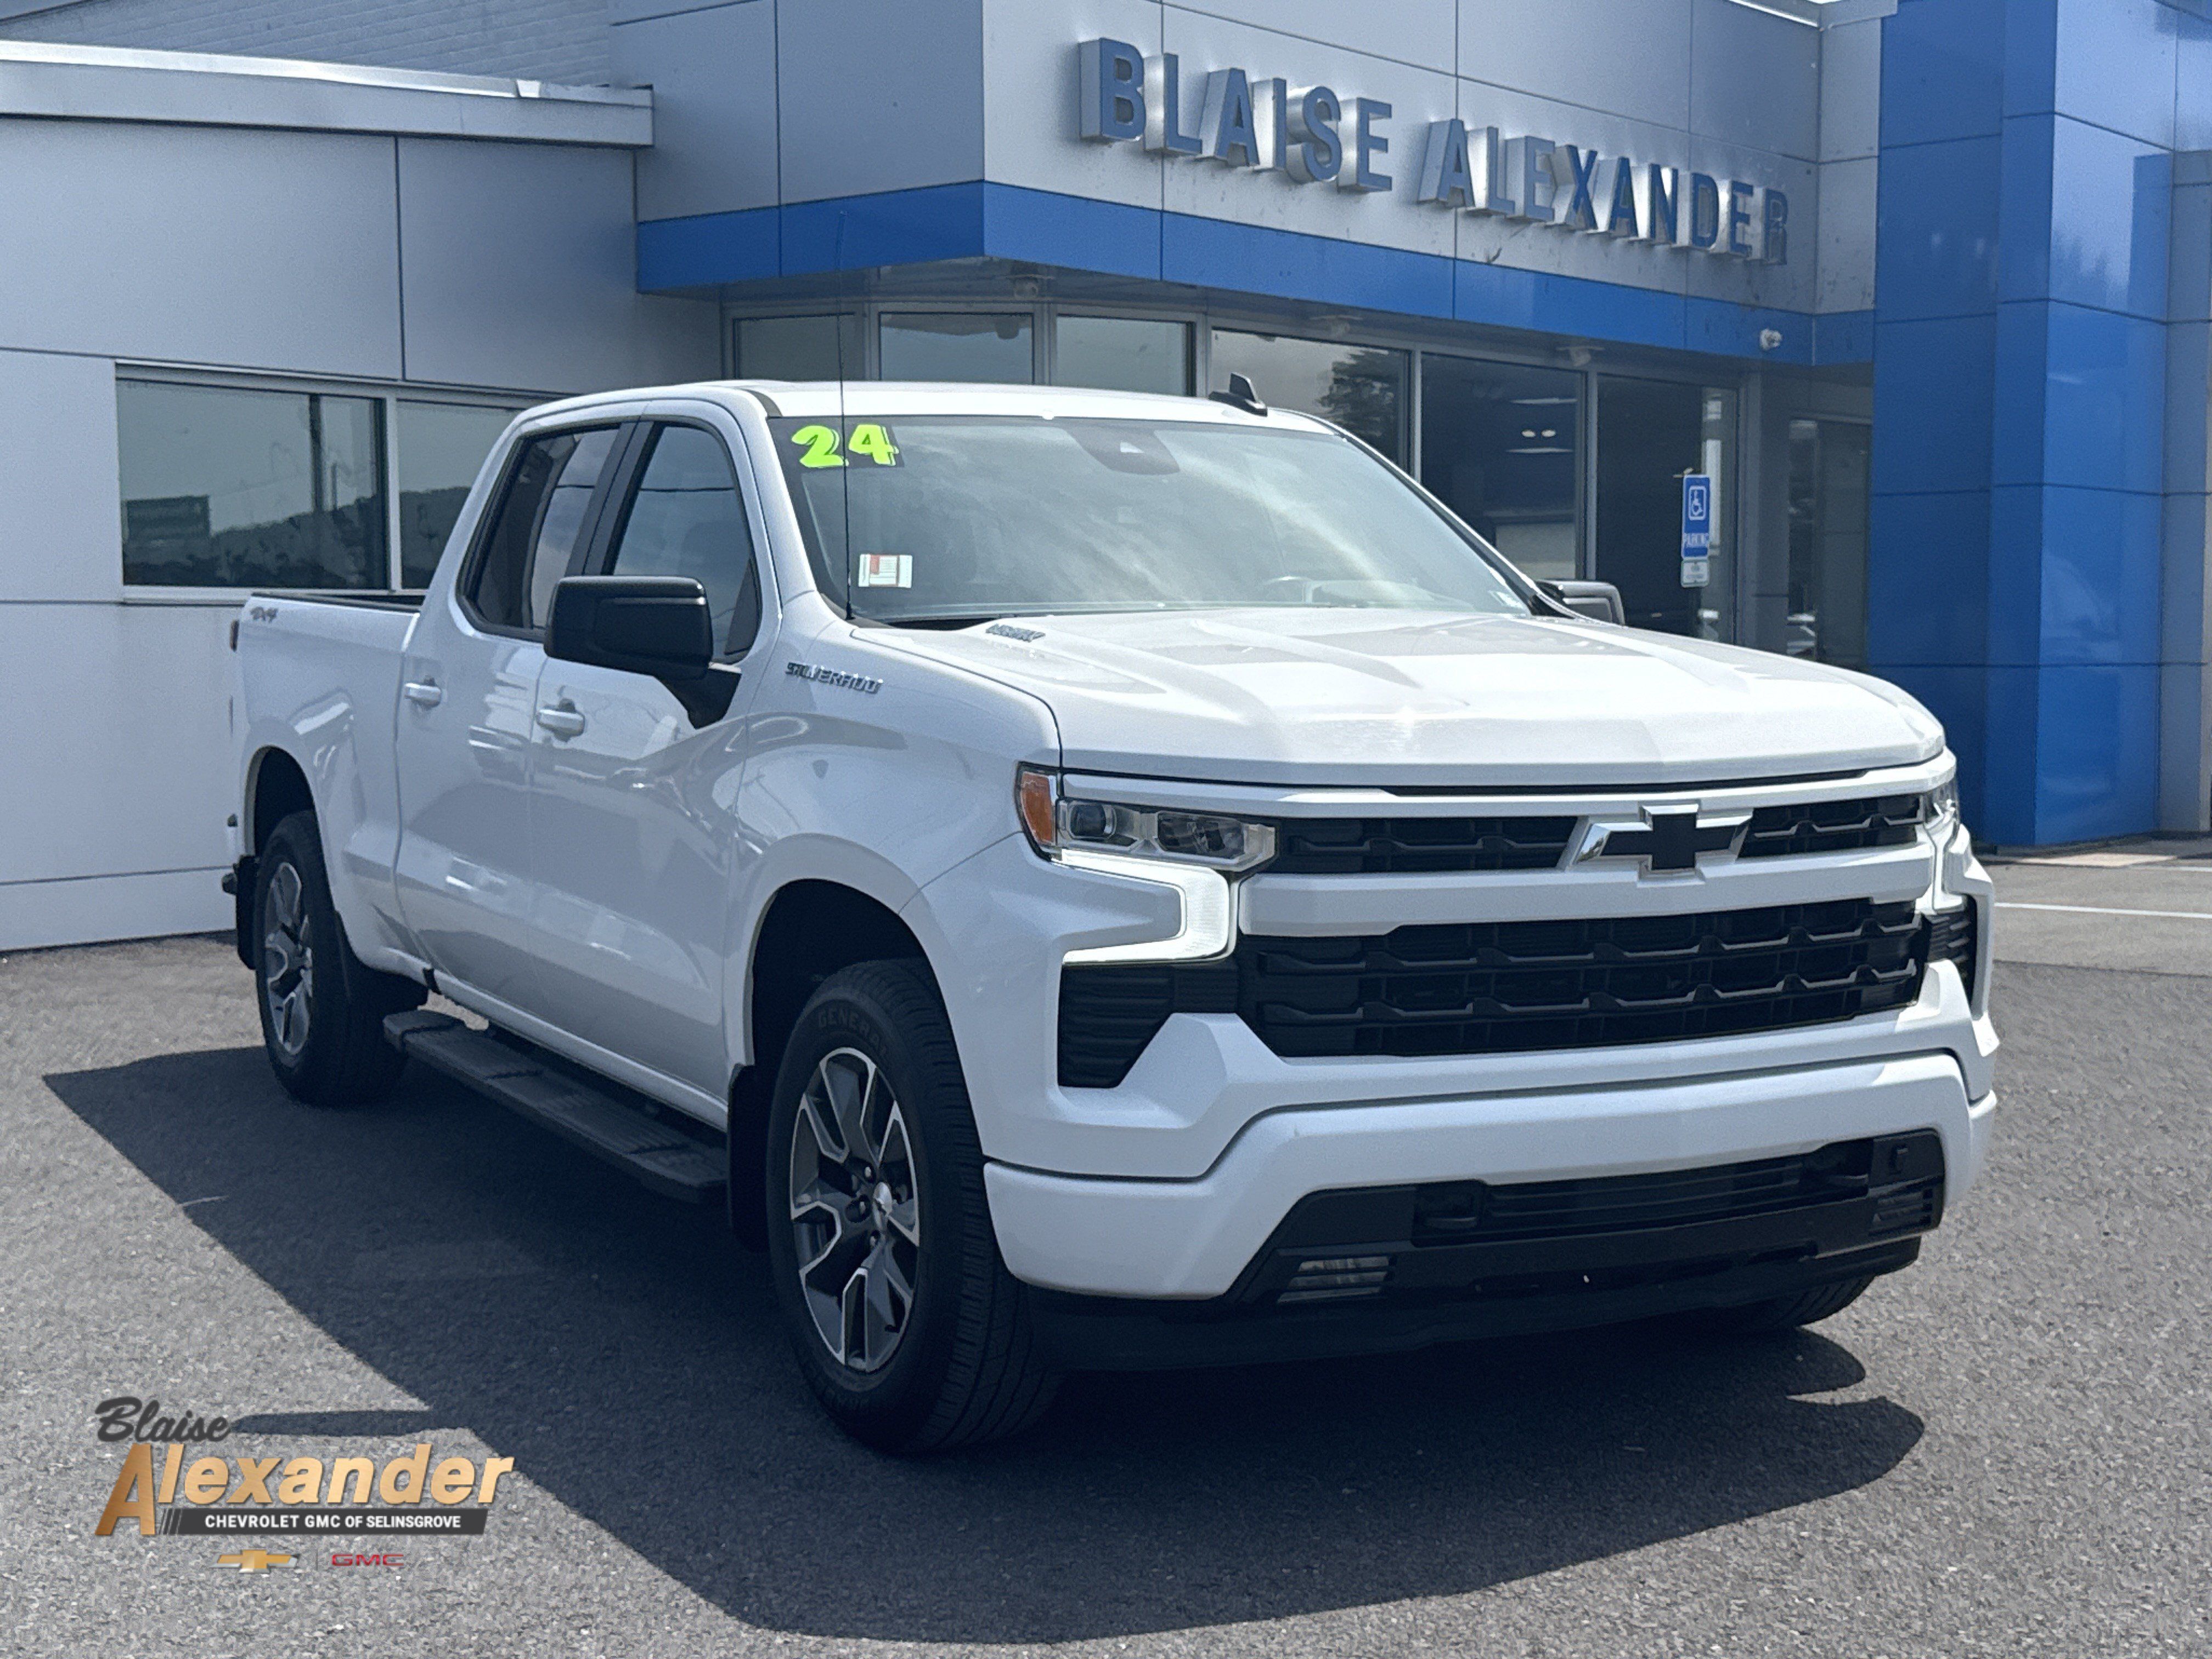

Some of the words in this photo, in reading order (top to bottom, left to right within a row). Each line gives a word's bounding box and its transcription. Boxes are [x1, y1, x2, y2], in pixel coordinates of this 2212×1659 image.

[1081, 37, 1392, 193] BLAISE
[1417, 117, 1788, 265] ALEXANDER
[792, 424, 899, 468] 24
[785, 662, 884, 694] SILVERADO
[818, 1007, 887, 1057] GENERAL
